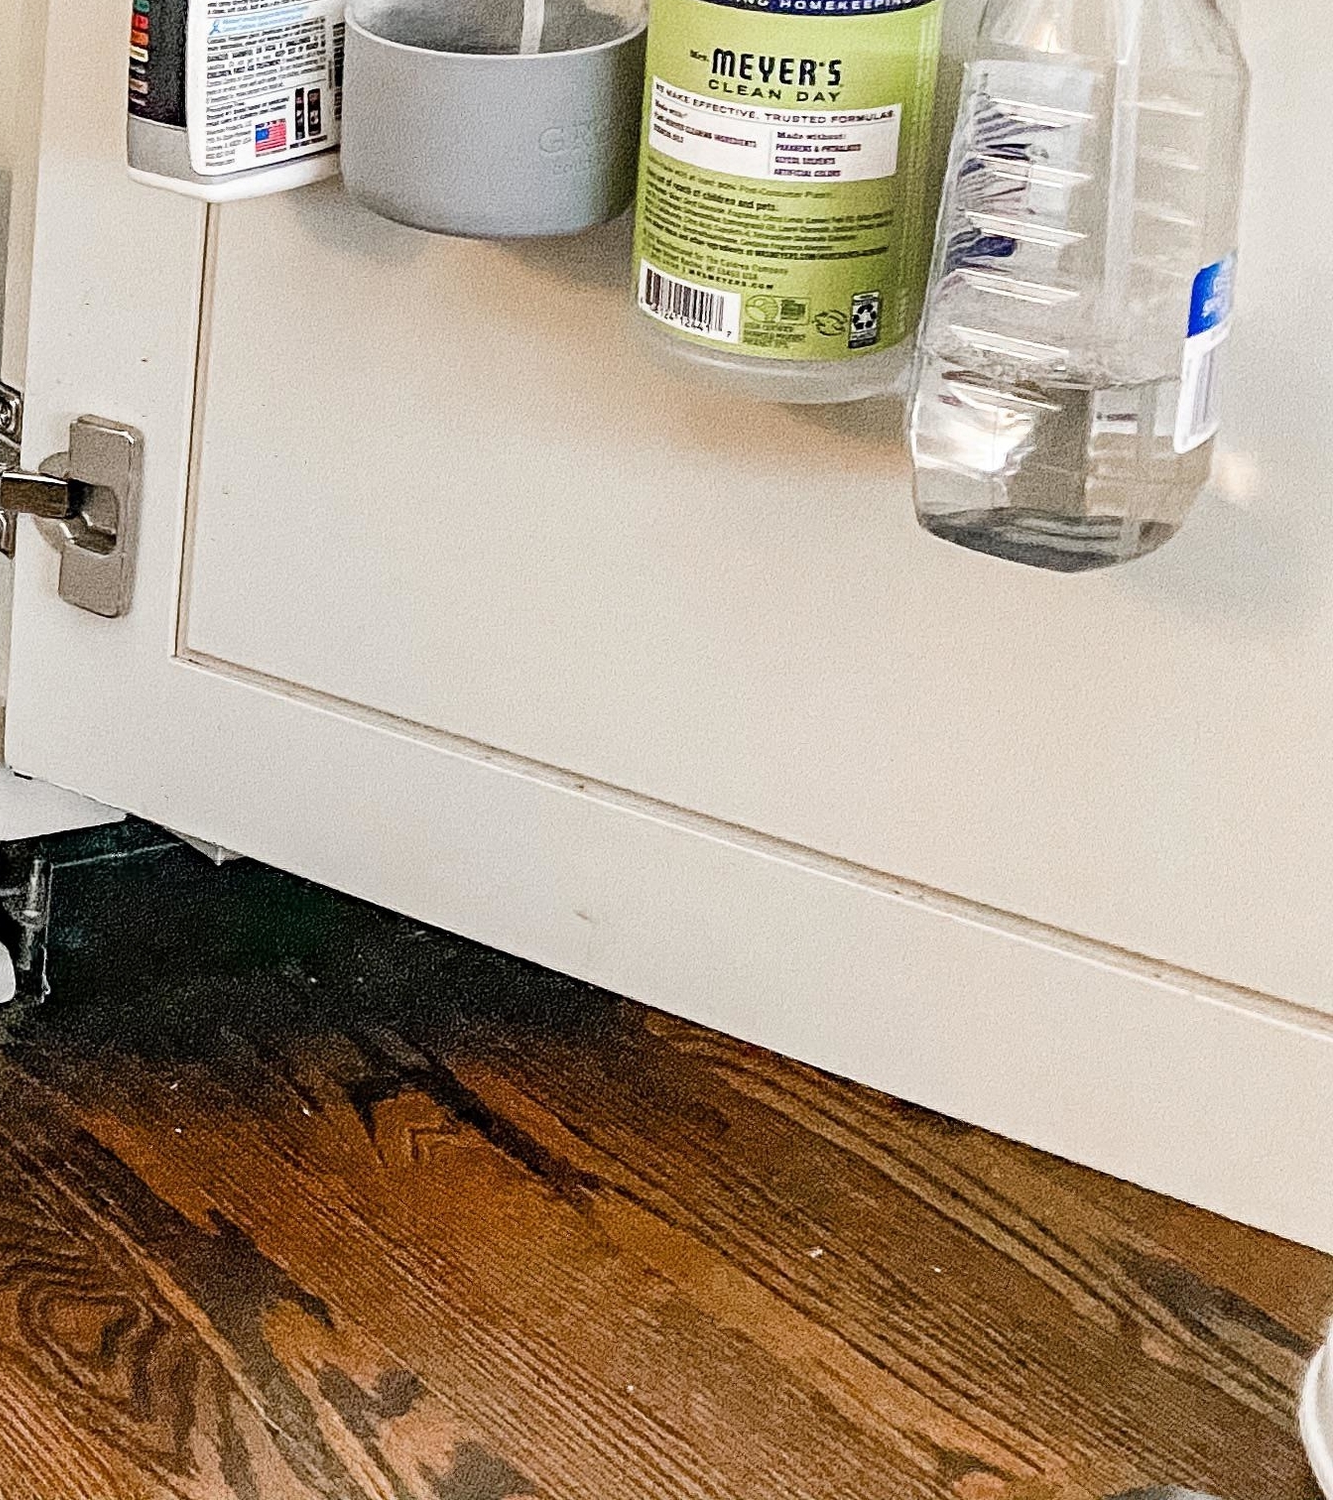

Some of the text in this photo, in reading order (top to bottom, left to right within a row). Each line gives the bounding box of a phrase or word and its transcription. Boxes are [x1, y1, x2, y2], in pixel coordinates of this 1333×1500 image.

[711, 48, 842, 87] MEYER'S
[708, 79, 842, 102] CLEAN DAY
[764, 112, 826, 124] TRUSTED
